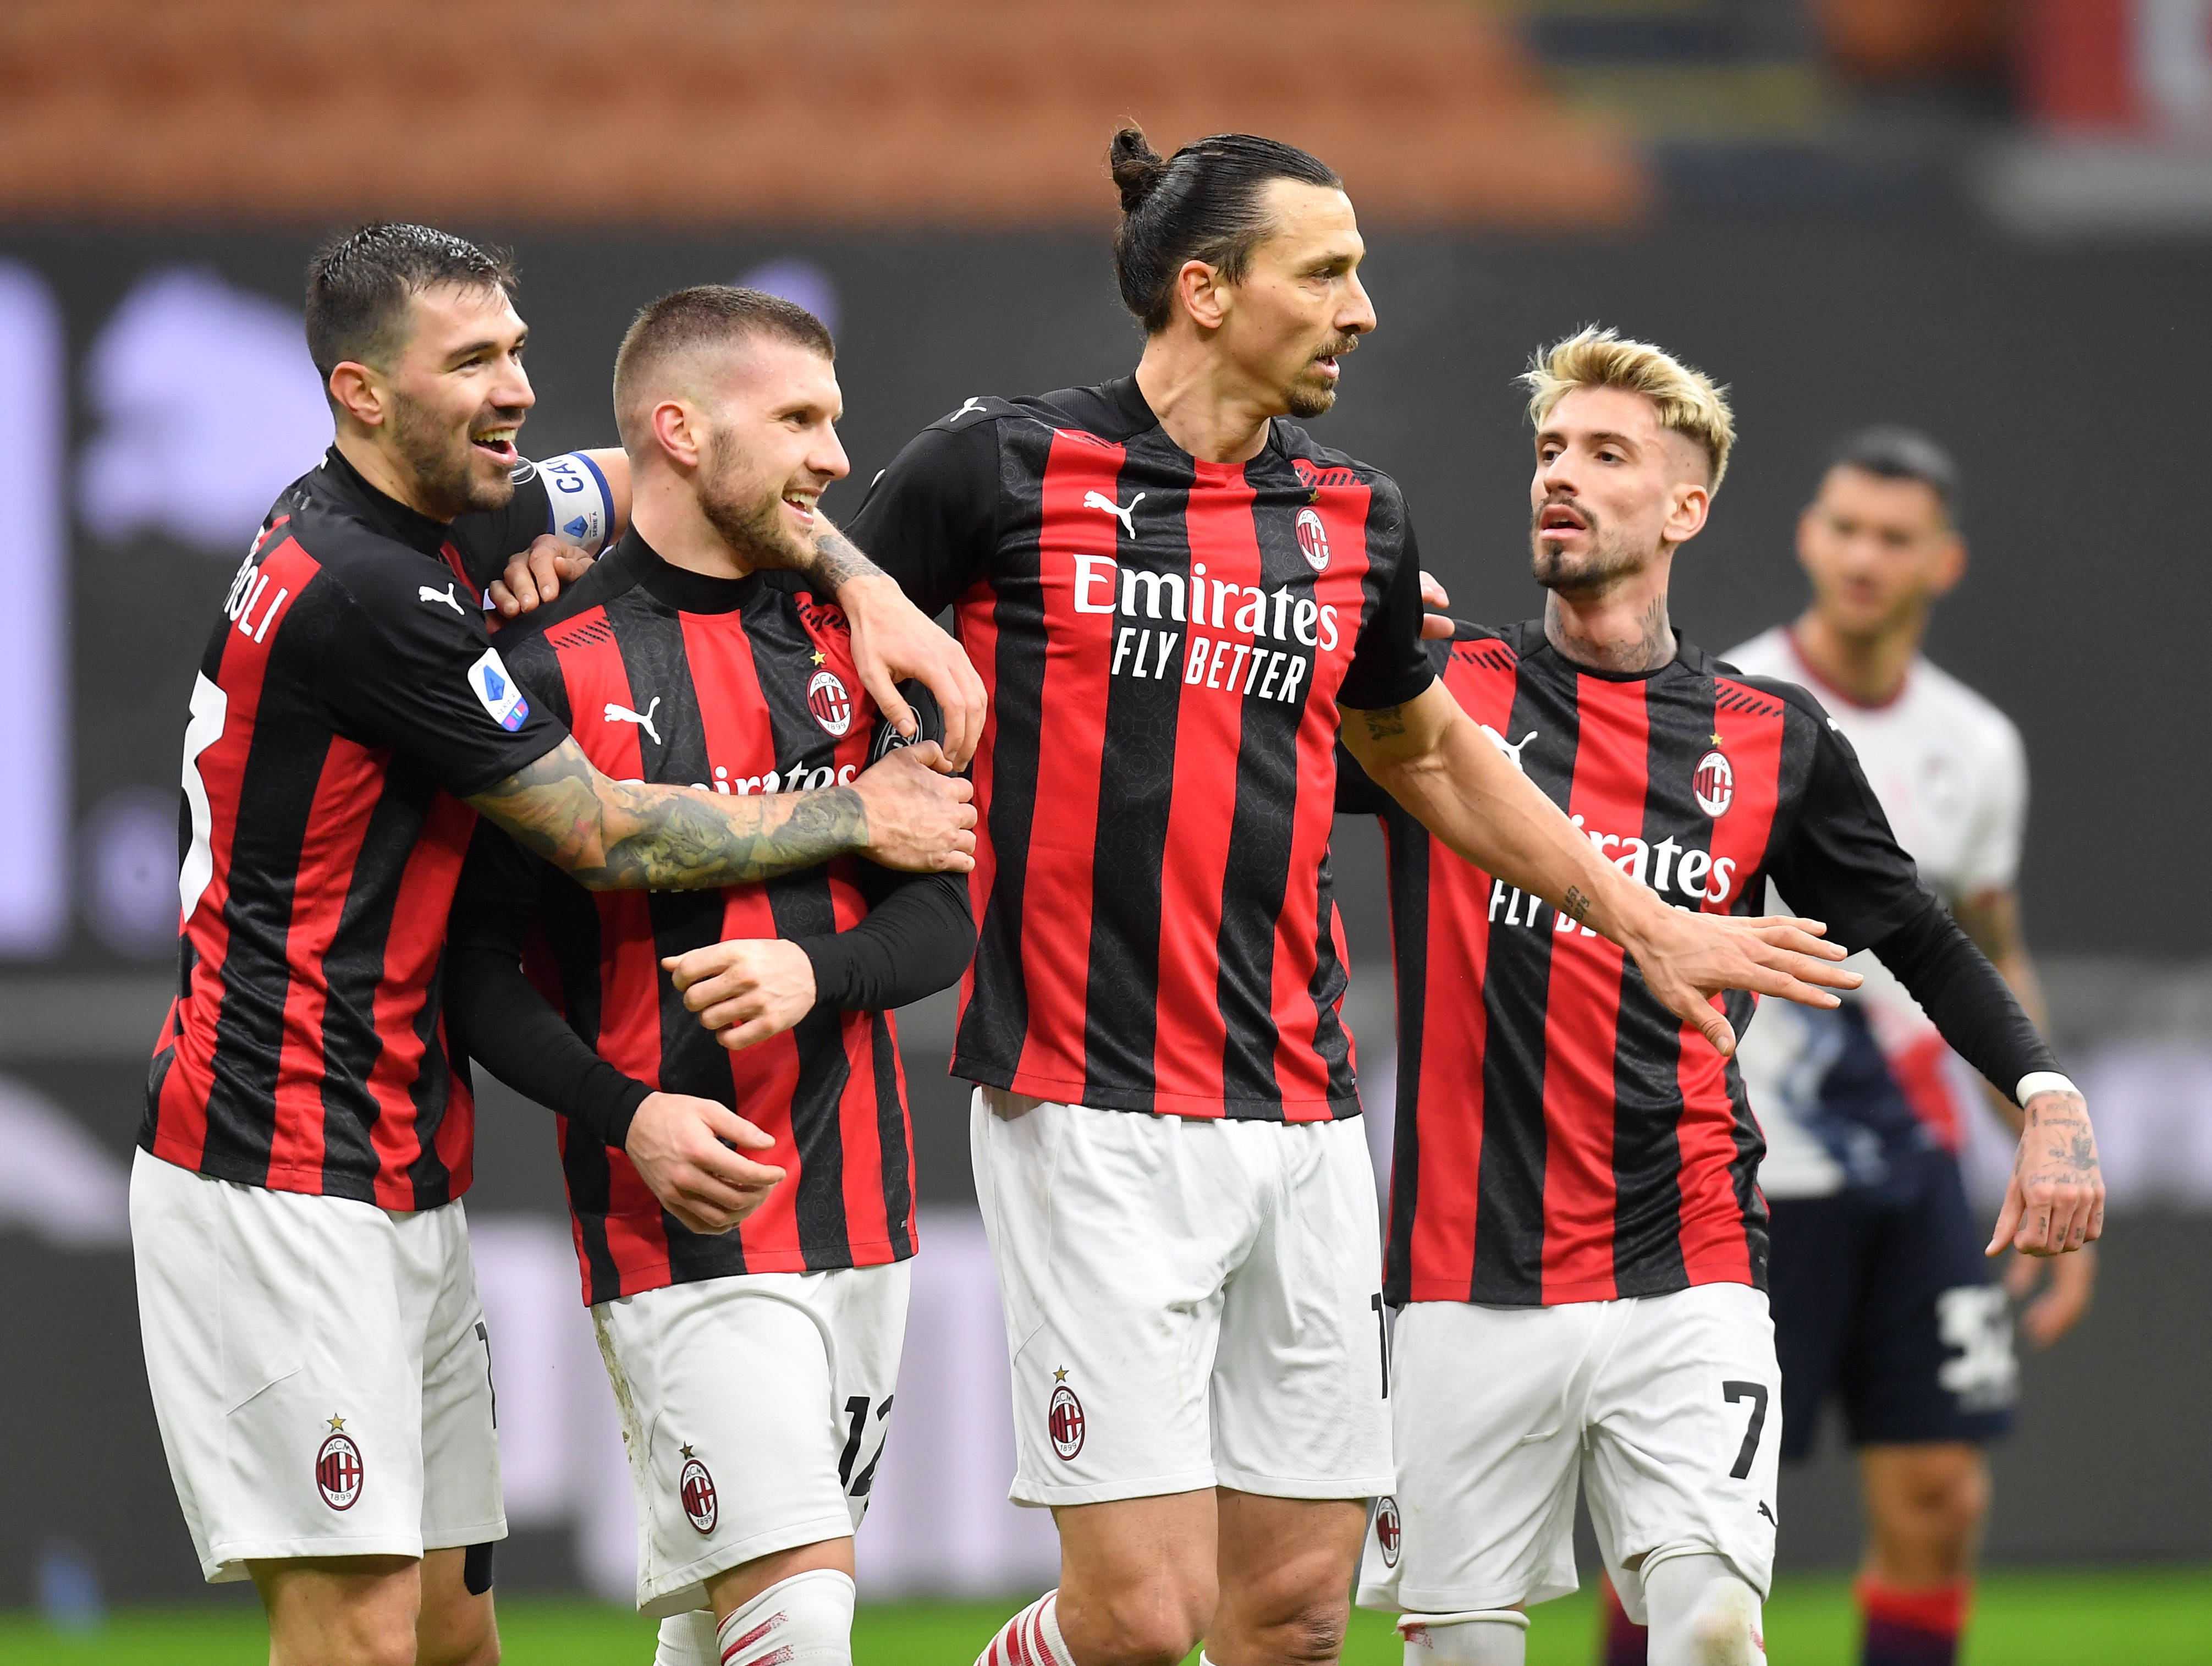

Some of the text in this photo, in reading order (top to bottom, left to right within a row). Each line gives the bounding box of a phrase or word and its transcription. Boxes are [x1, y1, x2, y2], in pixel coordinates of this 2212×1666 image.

[1073, 553, 1339, 652] Emirates
[1111, 627, 1307, 704] FLY BETTER
[814, 674, 837, 689] ACM
[1704, 755, 1726, 770] ACM
[1571, 813, 1736, 903] rates
[1055, 1392, 1074, 1407] ACM
[1722, 1380, 1769, 1480] 7
[326, 1440, 351, 1454] ACM
[1060, 1442, 1077, 1451] 1899
[685, 1466, 704, 1482] ACM
[330, 1492, 352, 1501] 1899
[696, 1514, 713, 1526] 1899
